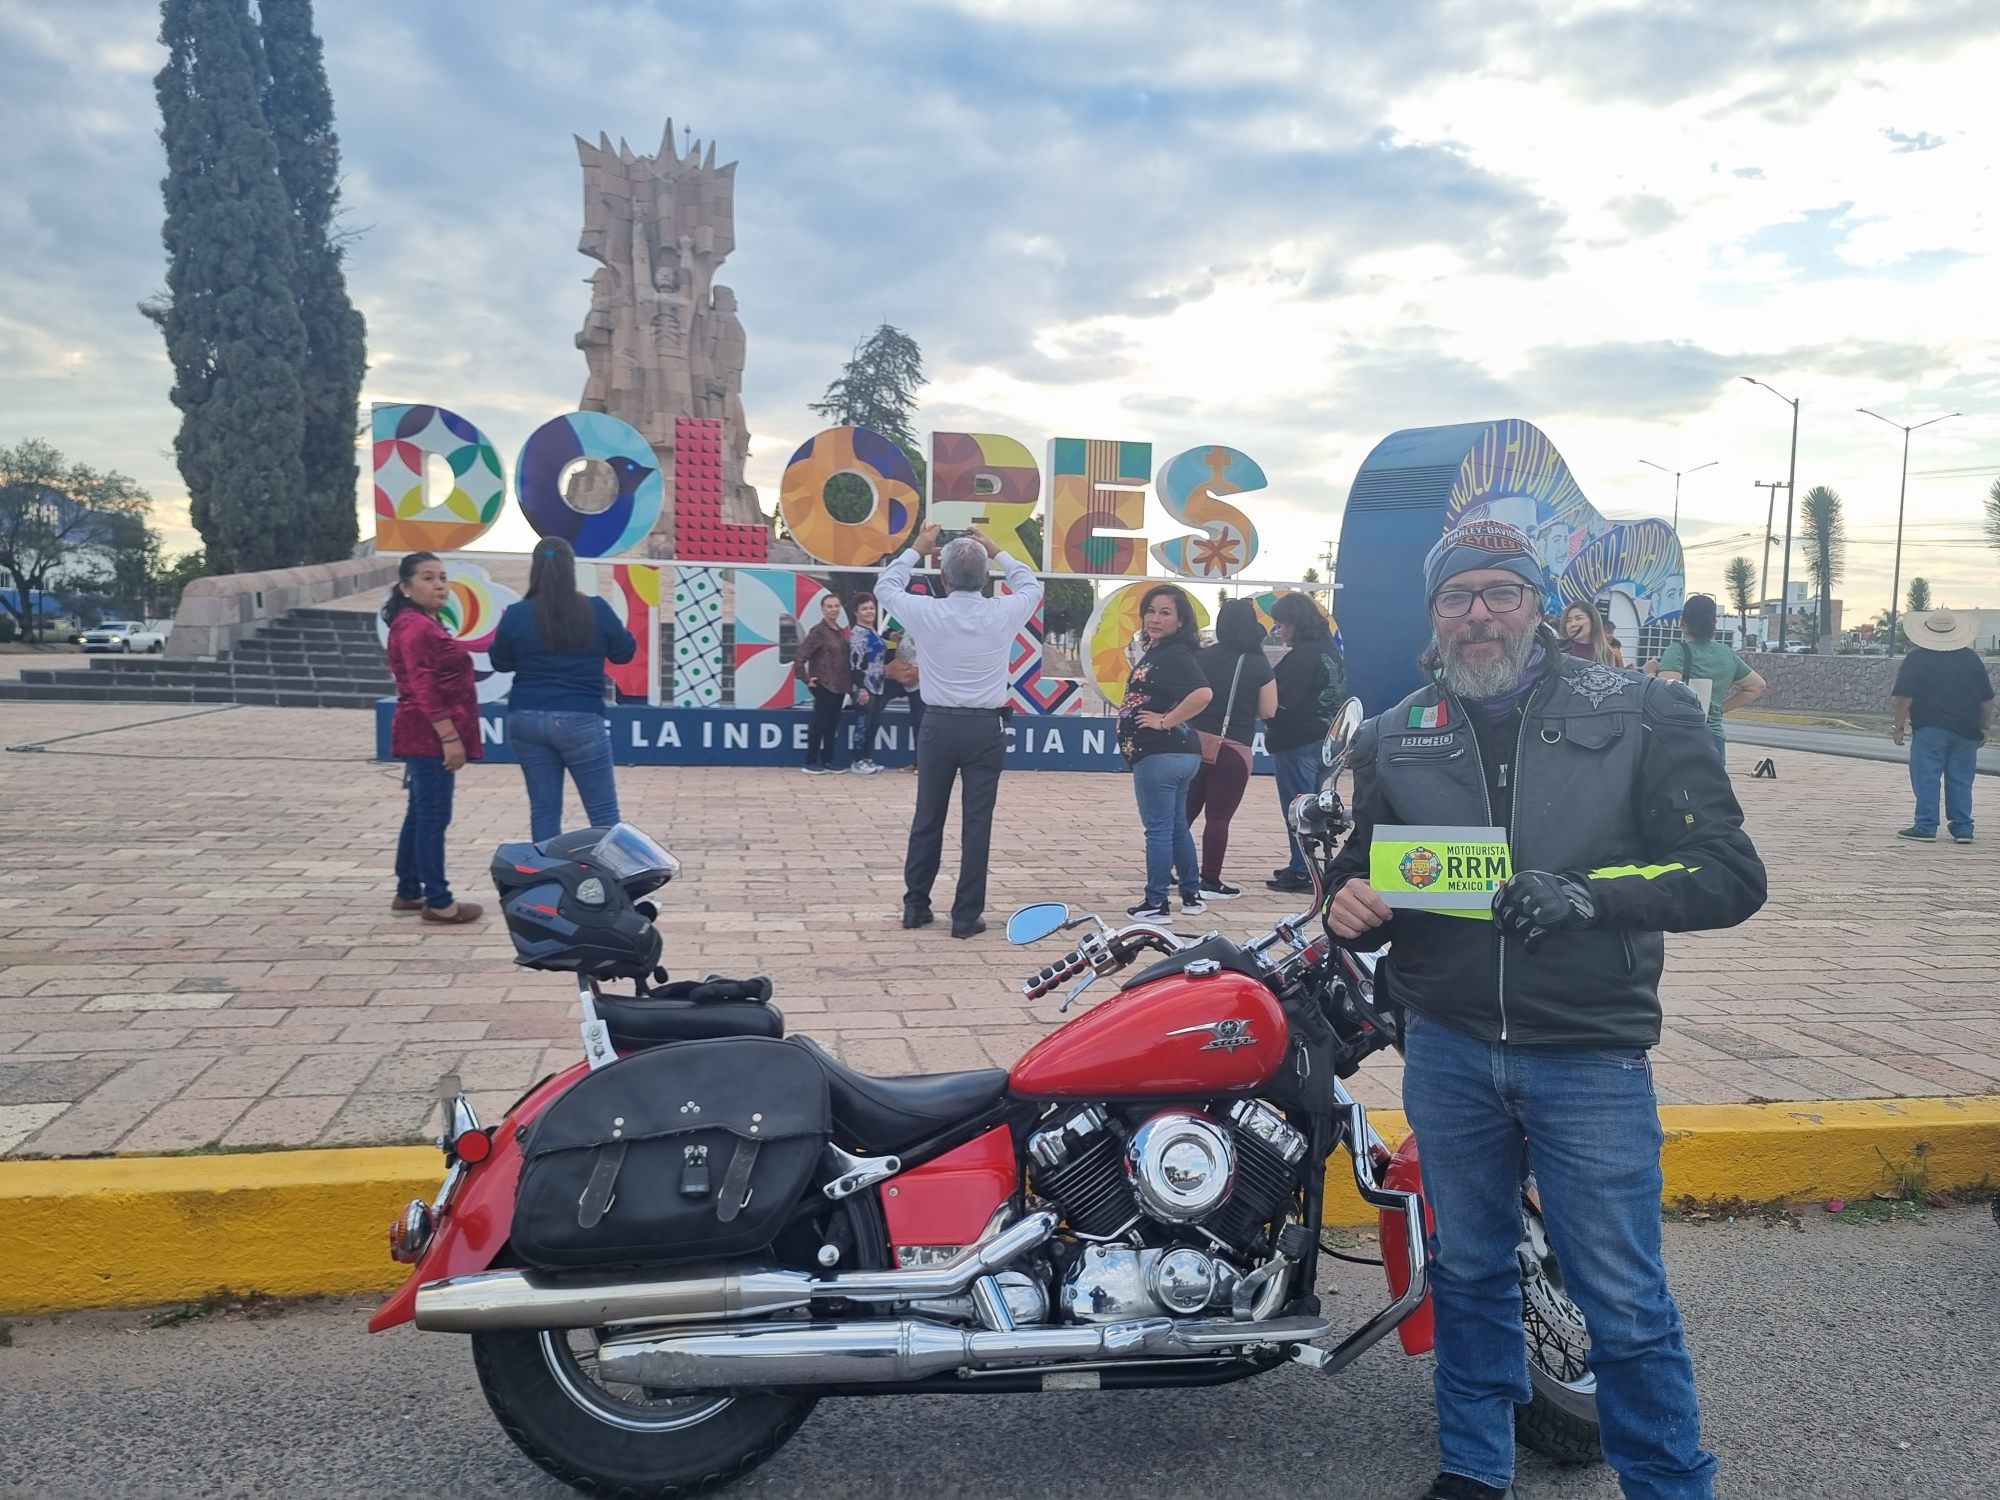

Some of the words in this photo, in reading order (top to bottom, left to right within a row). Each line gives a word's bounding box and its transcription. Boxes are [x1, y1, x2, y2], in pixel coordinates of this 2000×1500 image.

[373, 402, 1268, 578] DOLORES
[1466, 535, 1515, 549] CYCLES
[1576, 533, 1616, 598] PUEBLO
[631, 721, 682, 748] LA
[1402, 734, 1452, 747] BICHO
[1447, 845, 1506, 856] MOTOTURISTA
[1447, 856, 1506, 878] RRM
[1448, 879, 1483, 891] MÉXICO
